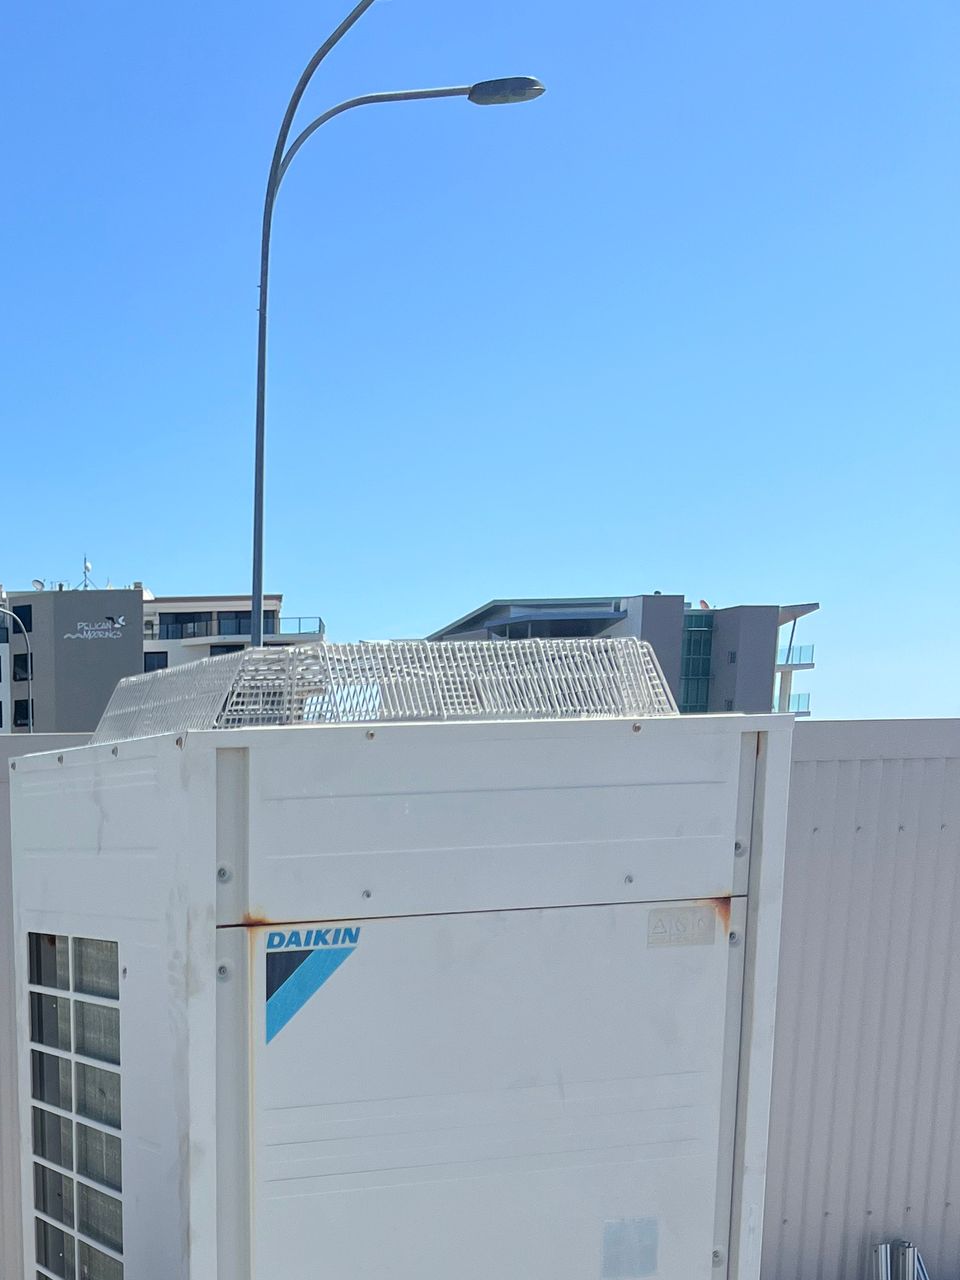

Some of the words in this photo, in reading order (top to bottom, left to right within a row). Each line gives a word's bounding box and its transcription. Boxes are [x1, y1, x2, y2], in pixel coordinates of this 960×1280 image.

[77, 621, 112, 630] PELICAN
[83, 630, 123, 640] MOORINGS
[266, 927, 361, 949] DAIKIN
